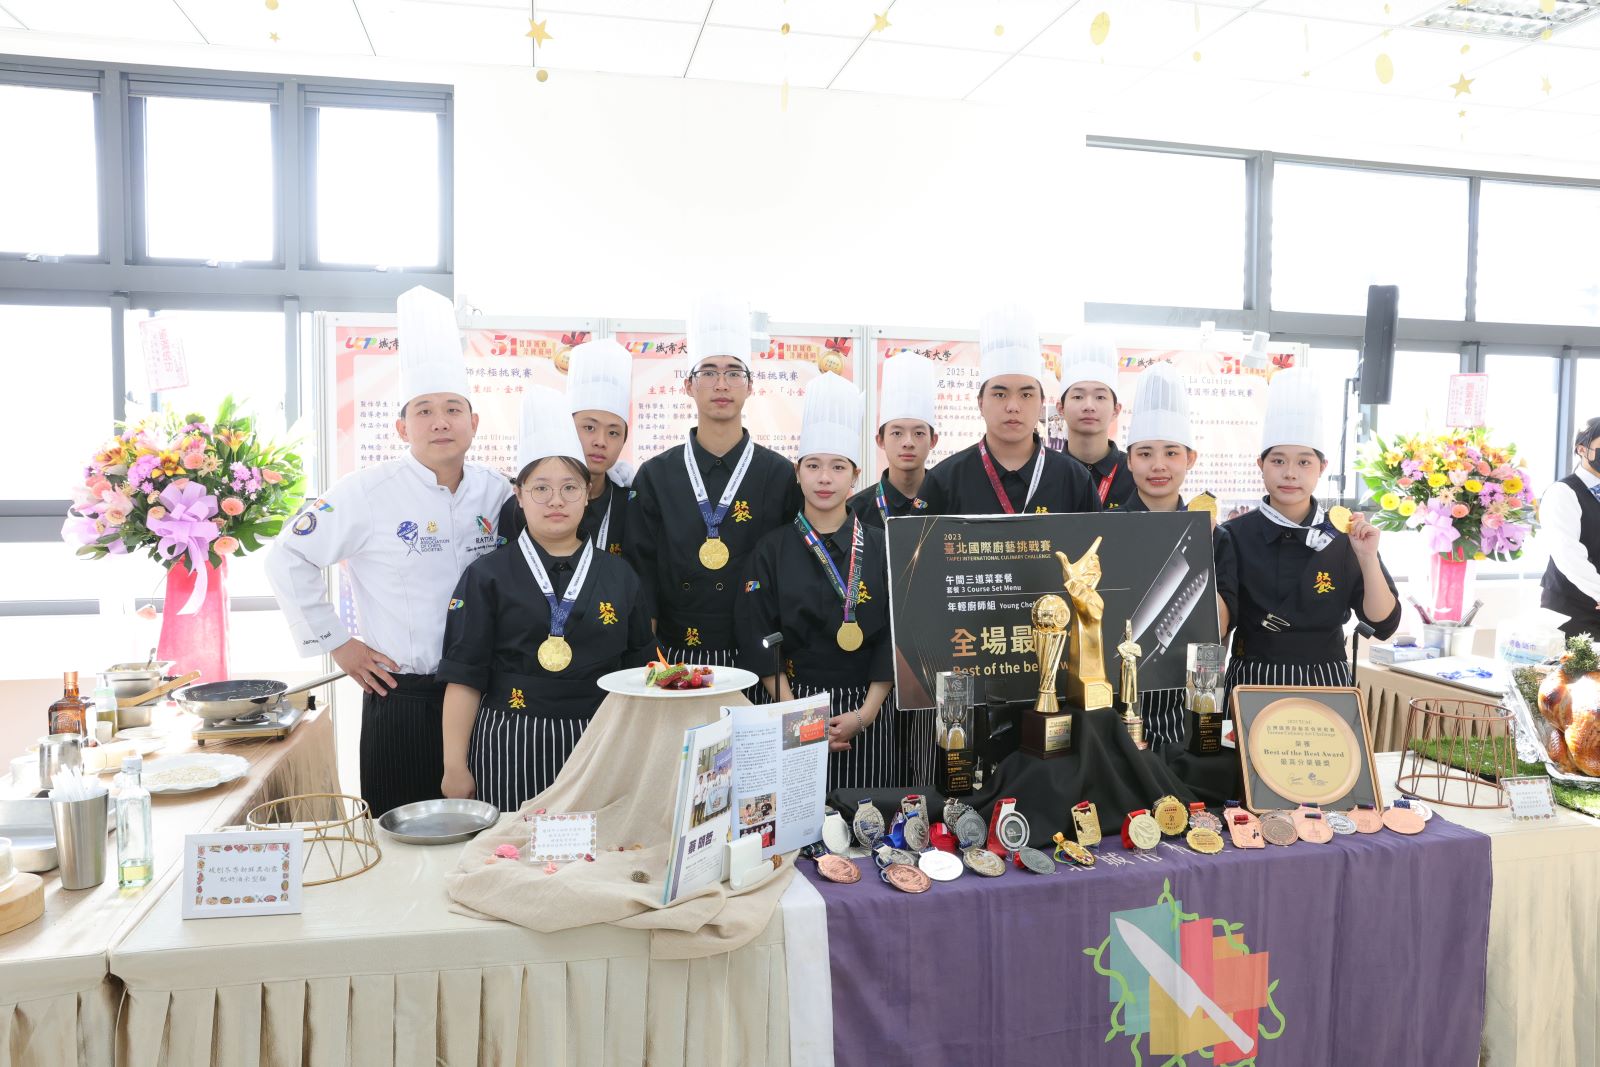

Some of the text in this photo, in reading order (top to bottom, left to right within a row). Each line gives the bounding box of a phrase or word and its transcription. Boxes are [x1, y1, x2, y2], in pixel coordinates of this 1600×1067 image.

[490, 335, 517, 356] 51
[946, 367, 965, 376] 2025
[943, 533, 962, 541] 2023
[943, 539, 1052, 555] 臺北國際廚藝挑戰賽
[945, 573, 1013, 586] 午間三道菜套餐
[947, 600, 997, 613] 年輕廚師組
[999, 602, 1020, 610] Young
[950, 625, 1037, 657] 全場最
[983, 662, 997, 676] of
[1000, 661, 1021, 674] the
[1023, 660, 1040, 673] be
[1263, 748, 1280, 756] Best
